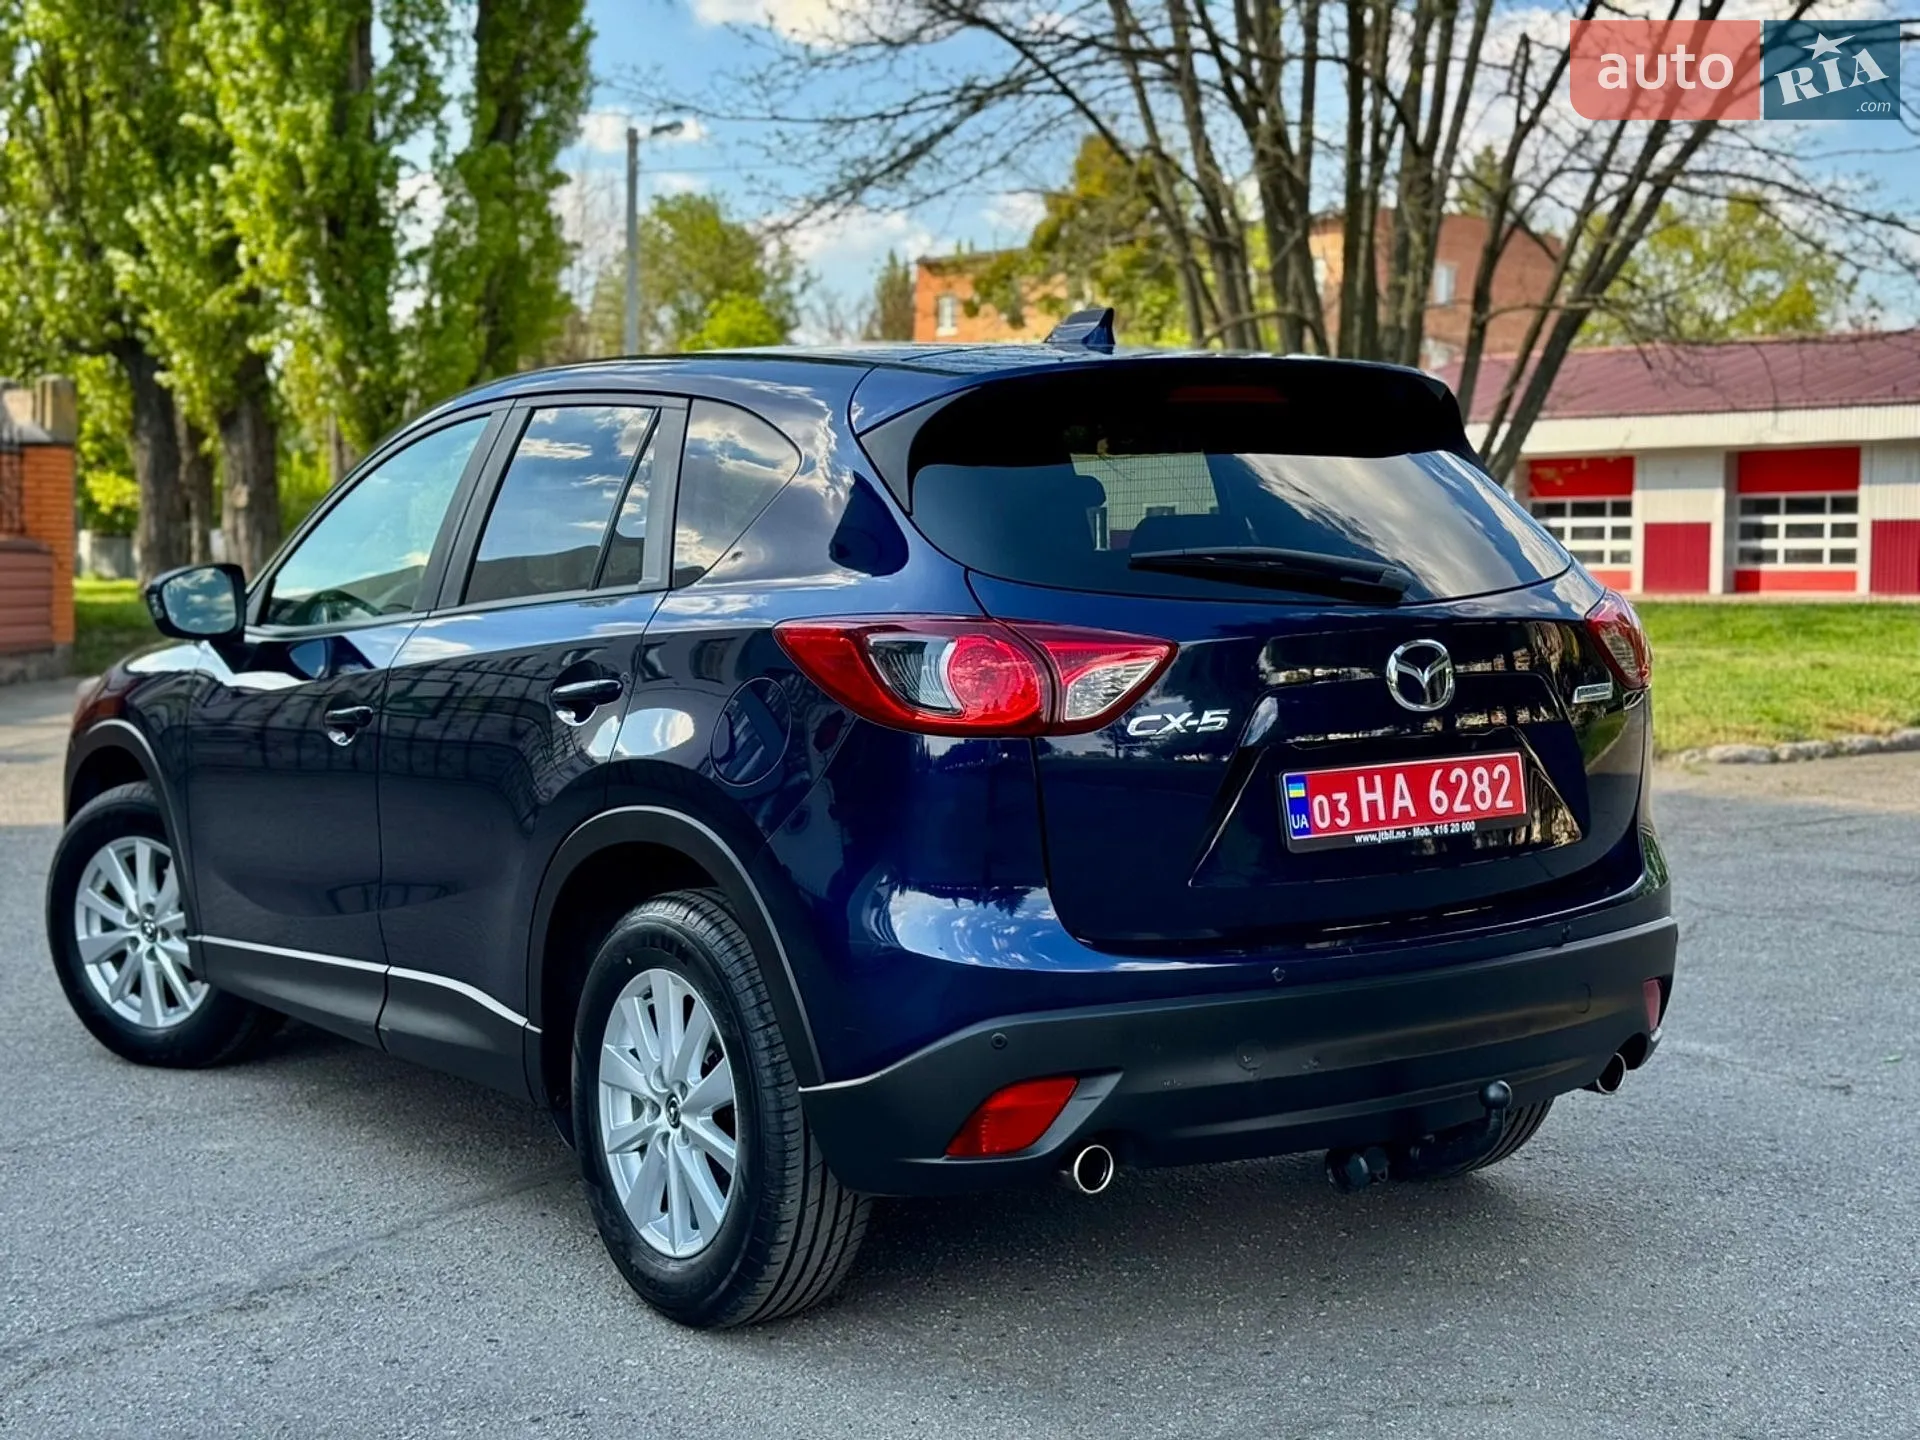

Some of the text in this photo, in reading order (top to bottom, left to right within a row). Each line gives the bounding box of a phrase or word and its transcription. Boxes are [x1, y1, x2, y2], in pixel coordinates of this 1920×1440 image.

[1127, 709, 1231, 735] CX-5
[1311, 763, 1513, 829] 03 HA 6282
[1291, 813, 1309, 829] UA
[1449, 822, 1460, 833] 20
[1461, 820, 1475, 831] 000
